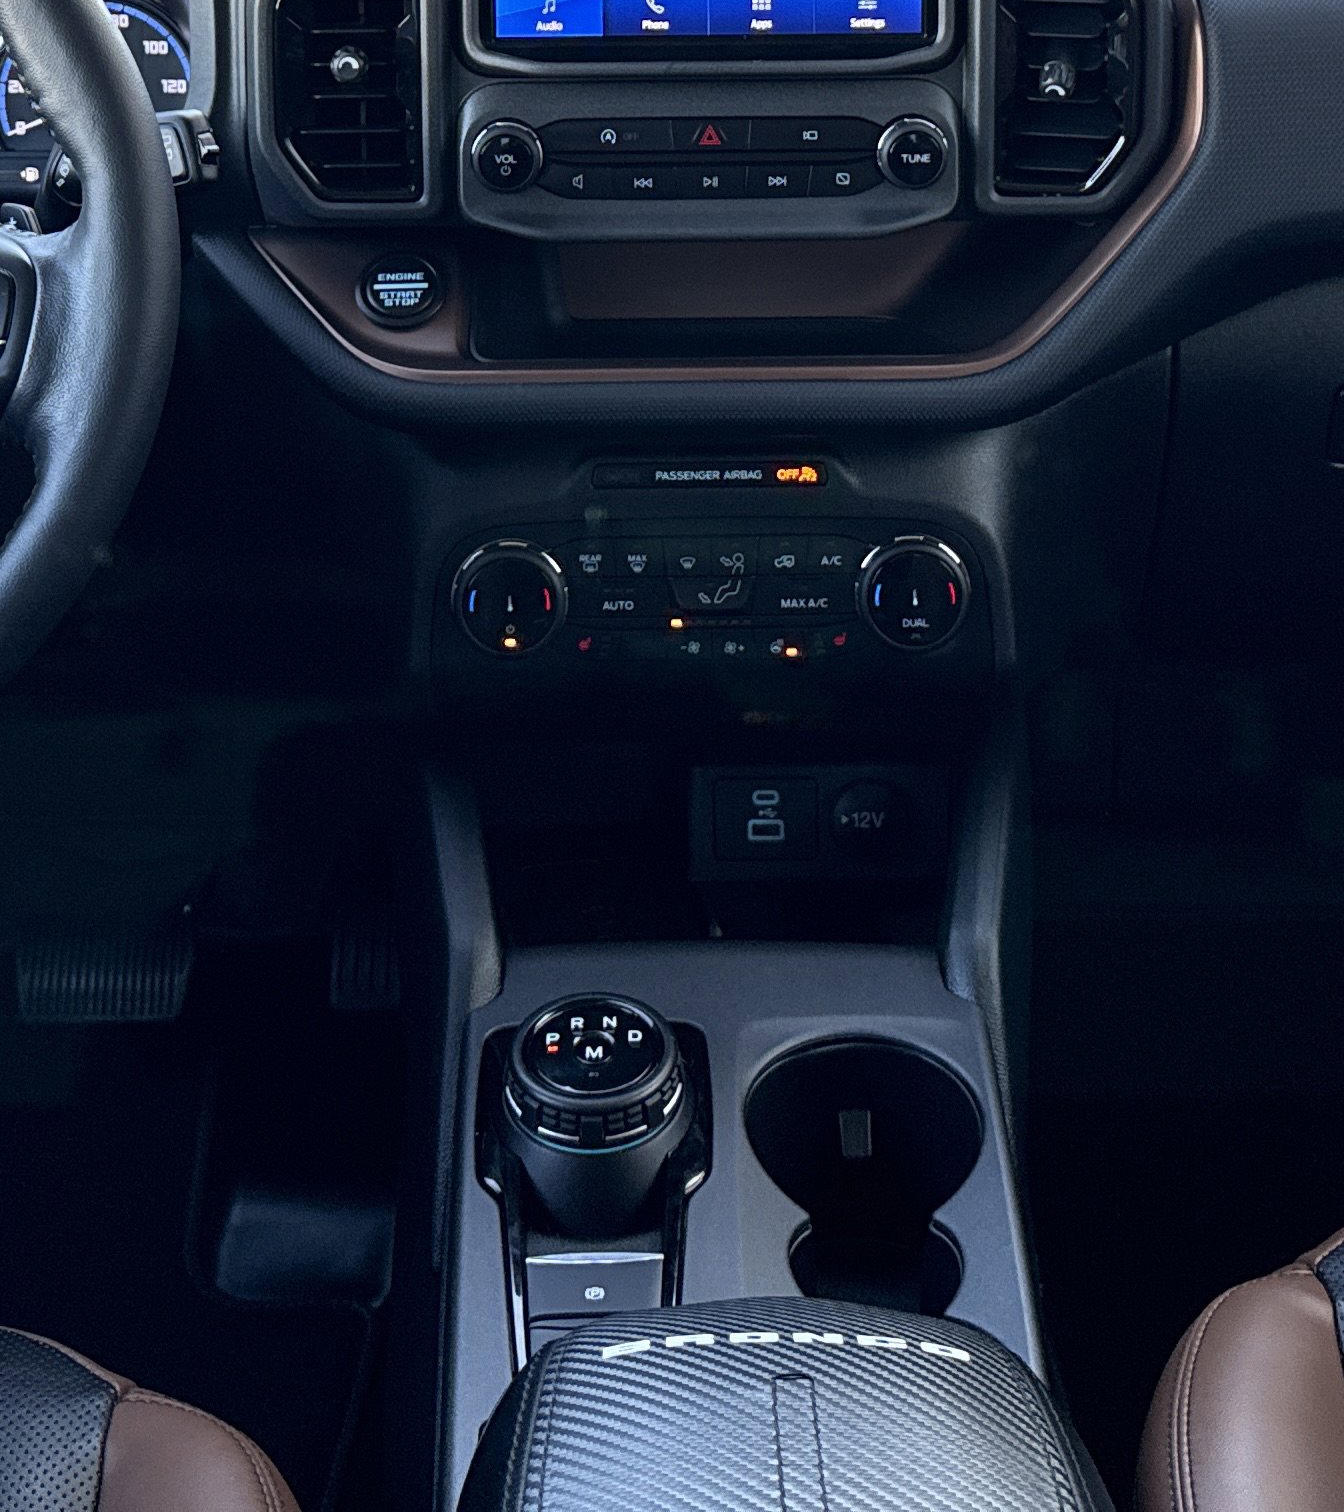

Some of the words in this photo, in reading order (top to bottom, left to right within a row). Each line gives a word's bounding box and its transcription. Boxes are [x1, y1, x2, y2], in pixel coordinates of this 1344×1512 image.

[536, 21, 563, 32] Audio
[641, 20, 669, 30] Phone
[750, 19, 773, 31] Apps
[850, 17, 885, 29] Settings
[143, 40, 169, 55] 100
[161, 79, 187, 94] 120
[494, 154, 517, 164] VOL
[901, 153, 931, 164] TUNE
[377, 272, 425, 281] ENGINE
[379, 290, 423, 299] START
[384, 298, 419, 306] STOP
[656, 470, 720, 481] PASSENGER
[723, 469, 763, 480] AIRBAG
[776, 468, 800, 481] OFF
[579, 554, 602, 562] REAR
[627, 554, 647, 562] MAX
[821, 555, 842, 566] A/C
[603, 600, 634, 611] AUTO
[781, 598, 806, 608] MAX
[807, 598, 828, 609] A/C
[902, 618, 930, 628] DUAL
[851, 811, 885, 828] 12V
[570, 1017, 584, 1029] R
[602, 1016, 617, 1028] N
[545, 1032, 560, 1045] P
[627, 1030, 643, 1042] D
[585, 1045, 603, 1059] M
[601, 1331, 970, 1361] BRONCO
